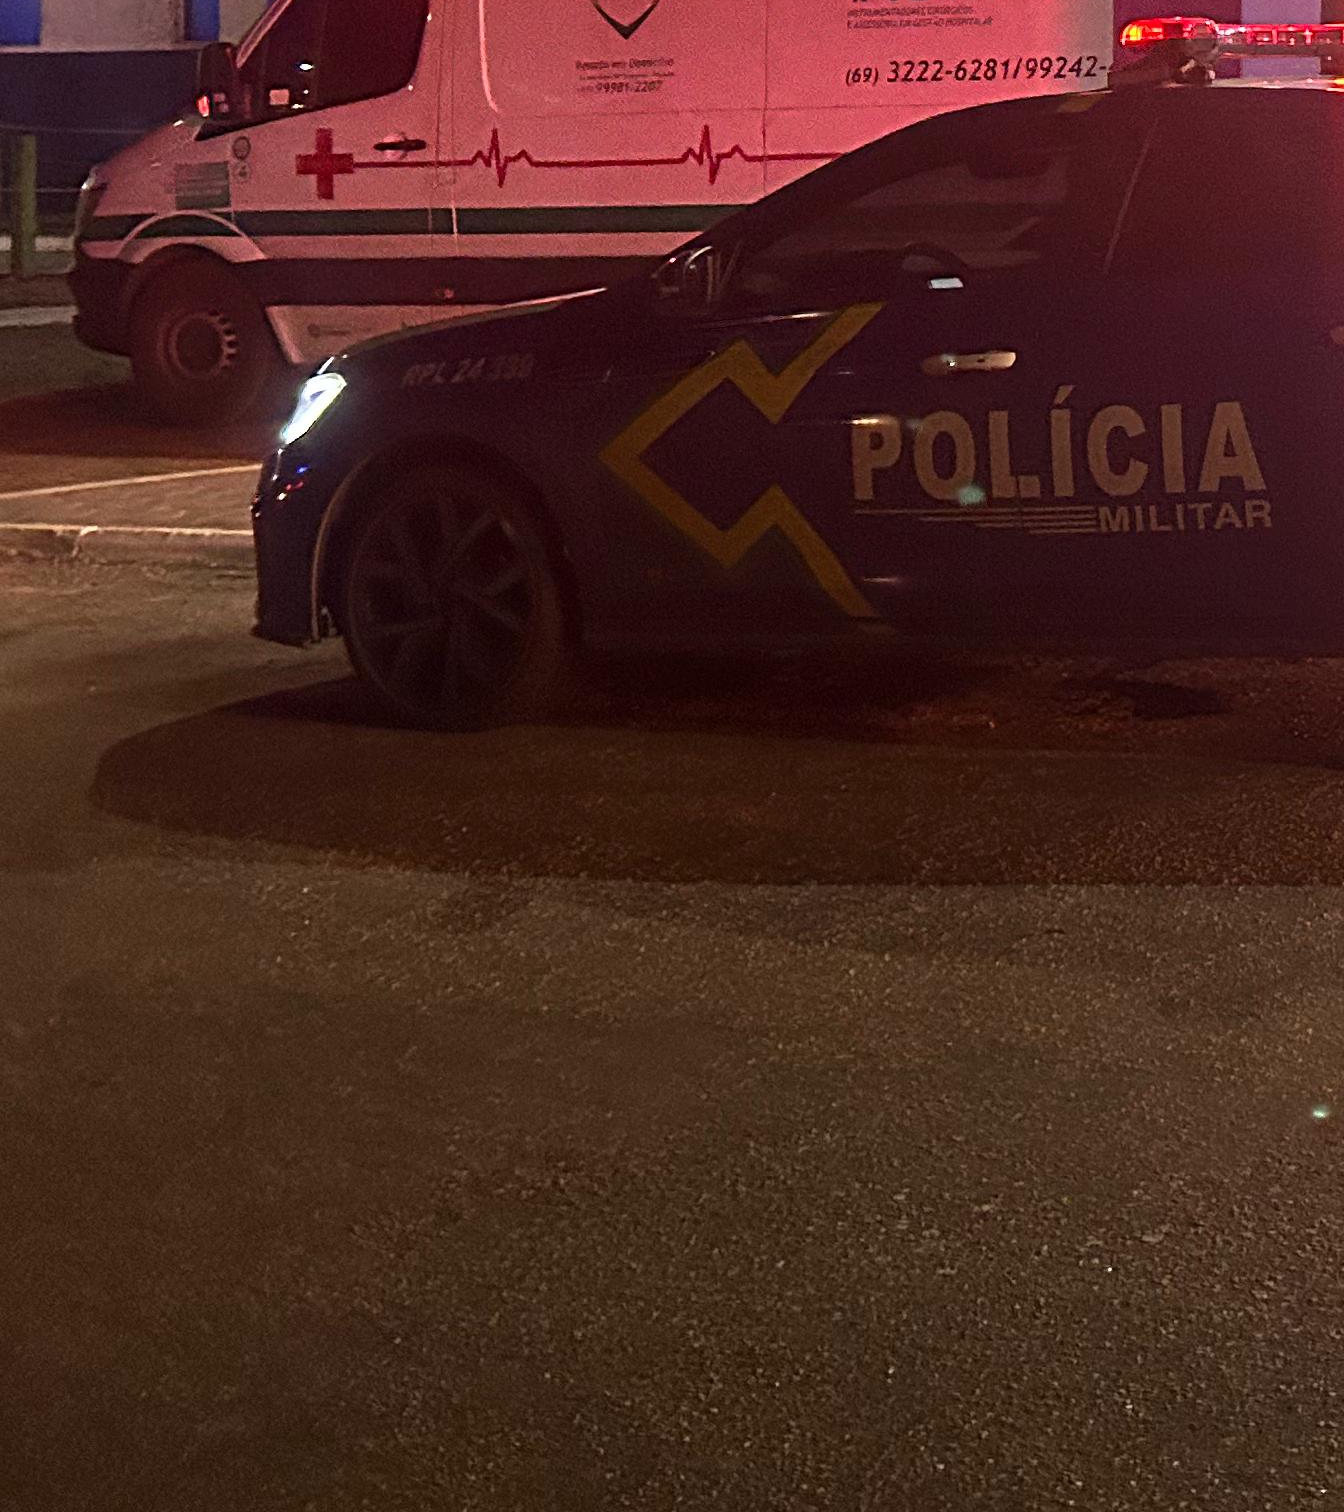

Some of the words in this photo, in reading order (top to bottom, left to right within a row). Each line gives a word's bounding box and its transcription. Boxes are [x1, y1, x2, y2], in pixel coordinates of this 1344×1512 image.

[845, 67, 880, 87] (69)
[885, 55, 1113, 84] 3222-6281/99242-
[850, 384, 1268, 501] POLÍCIA
[1099, 498, 1274, 534] MILITAR
